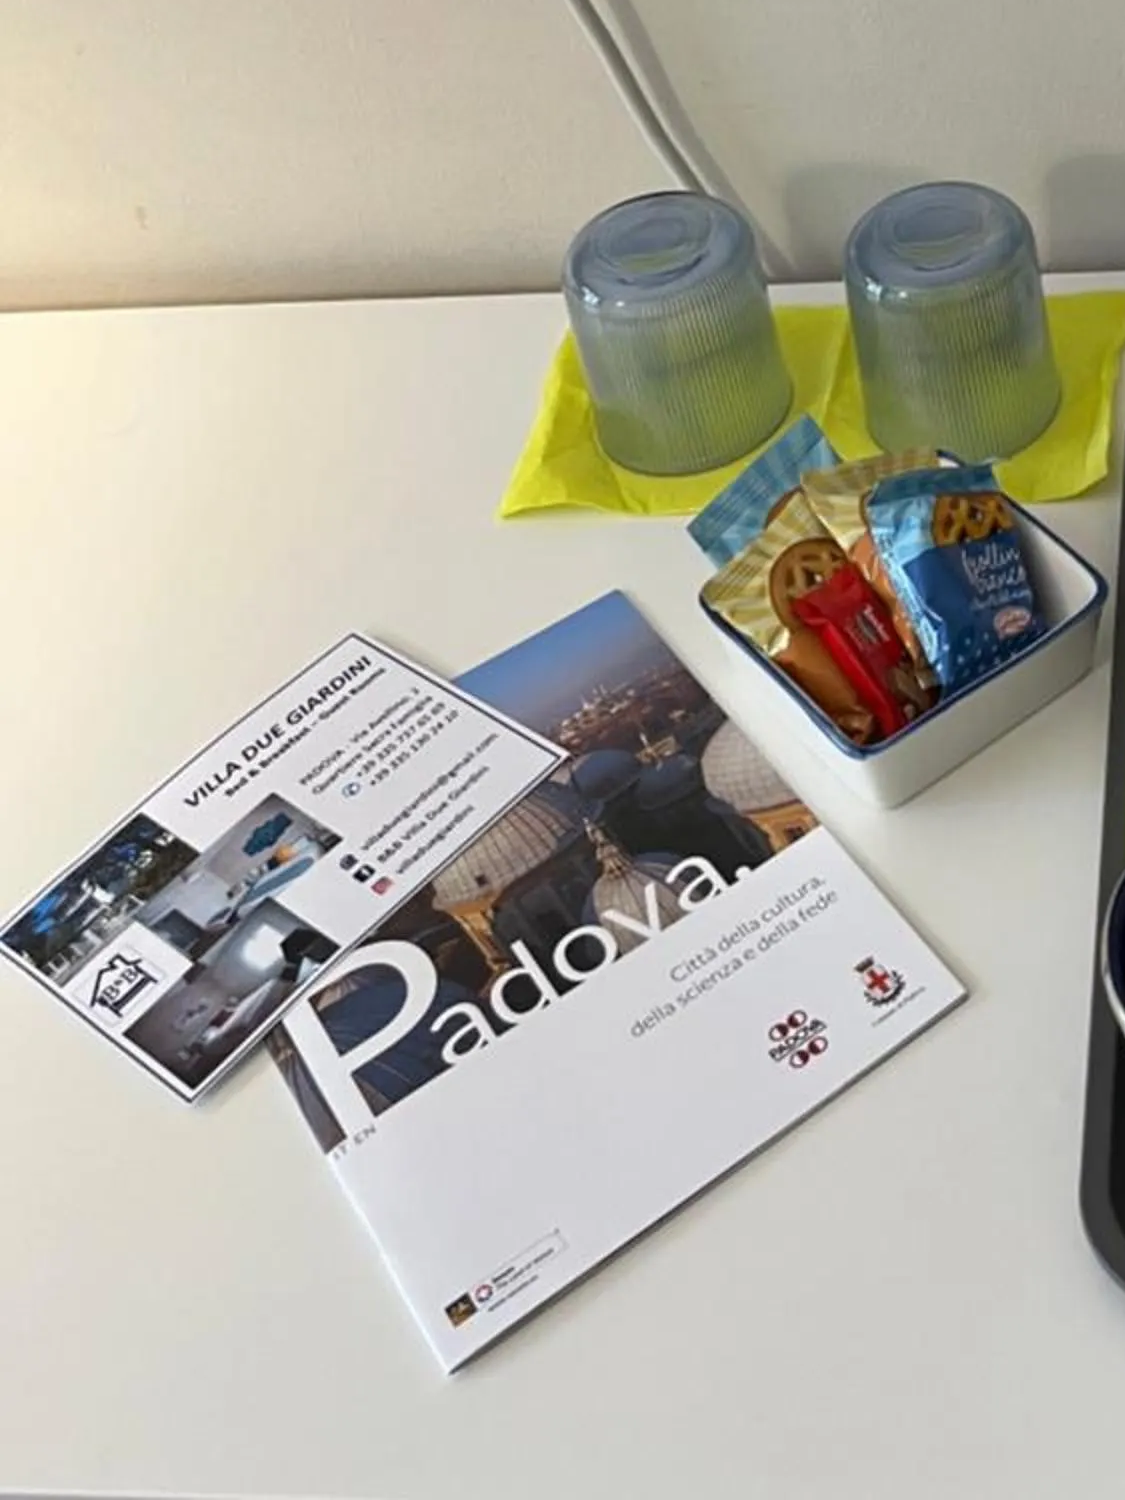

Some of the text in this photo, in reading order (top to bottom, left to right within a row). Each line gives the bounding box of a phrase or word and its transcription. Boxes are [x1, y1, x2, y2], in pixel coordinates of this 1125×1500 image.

[184, 655, 373, 808] VILLA DUE GIARDINI
[224, 778, 248, 797] Bed
[258, 727, 311, 769] Breakfast
[630, 890, 838, 1038] della scienza e della fede
[670, 876, 826, 983] Città della cultura,
[768, 1019, 828, 1061] PADOVA
